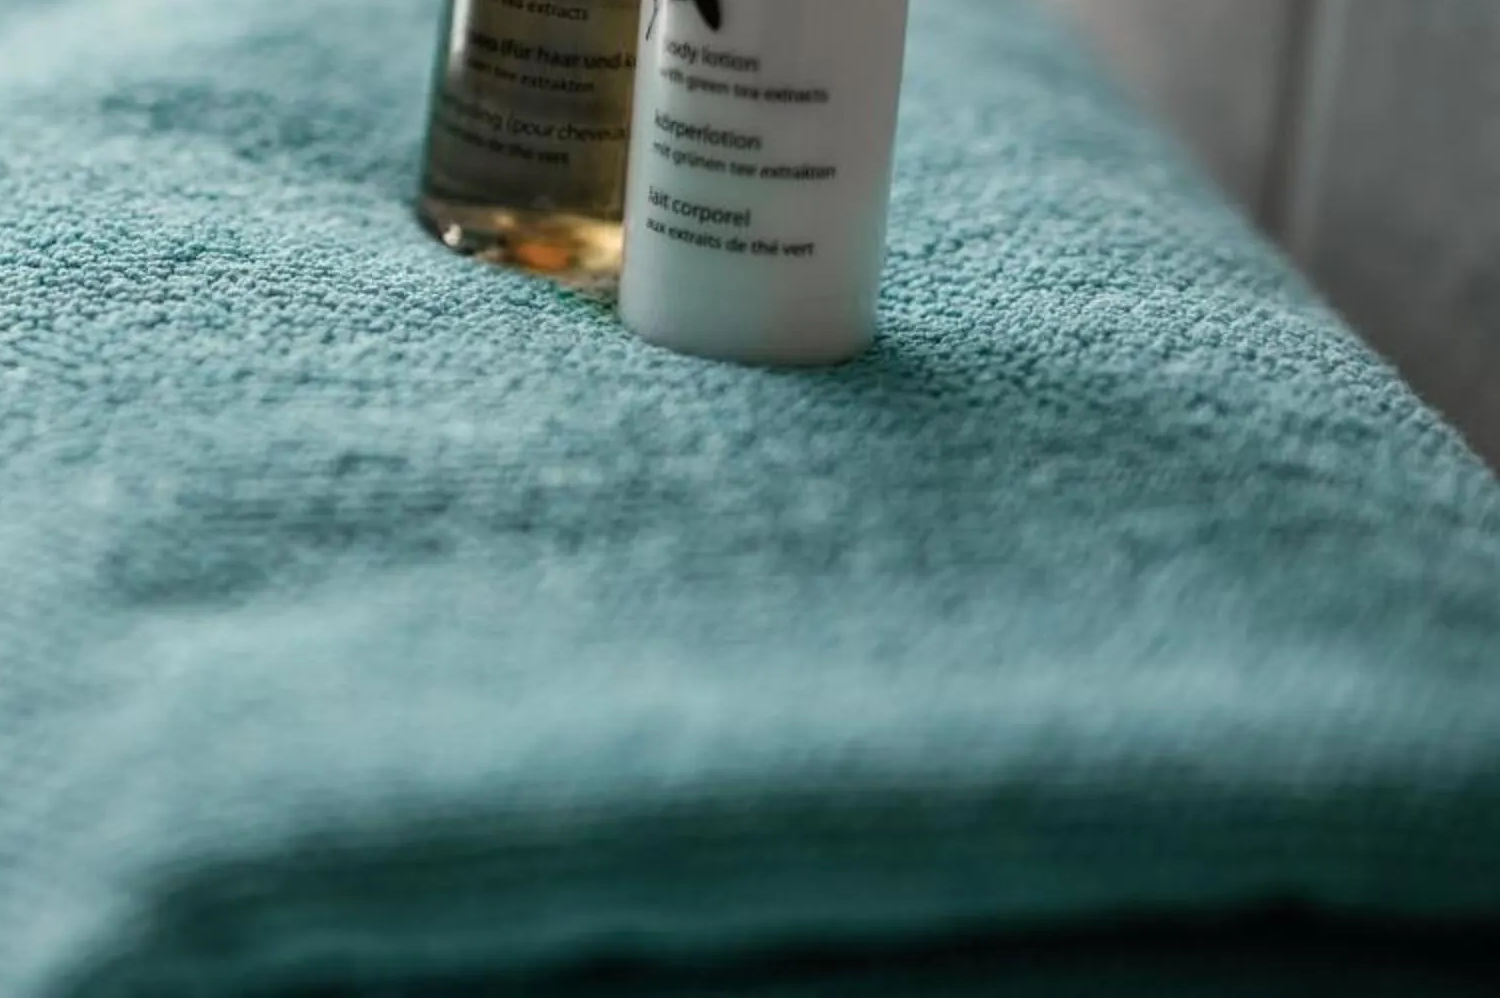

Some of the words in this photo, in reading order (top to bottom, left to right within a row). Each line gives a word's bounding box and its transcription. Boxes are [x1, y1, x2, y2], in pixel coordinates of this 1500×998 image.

[526, 0, 589, 21] extracts
[537, 45, 579, 68] haar
[701, 43, 760, 72] lotion
[686, 75, 729, 93] green
[763, 87, 829, 103] extracts
[648, 186, 671, 211] lait
[672, 199, 752, 227] corporel
[668, 227, 721, 249] extraits
[725, 236, 747, 253] de
[751, 238, 778, 257] thé
[783, 242, 815, 258] vert
